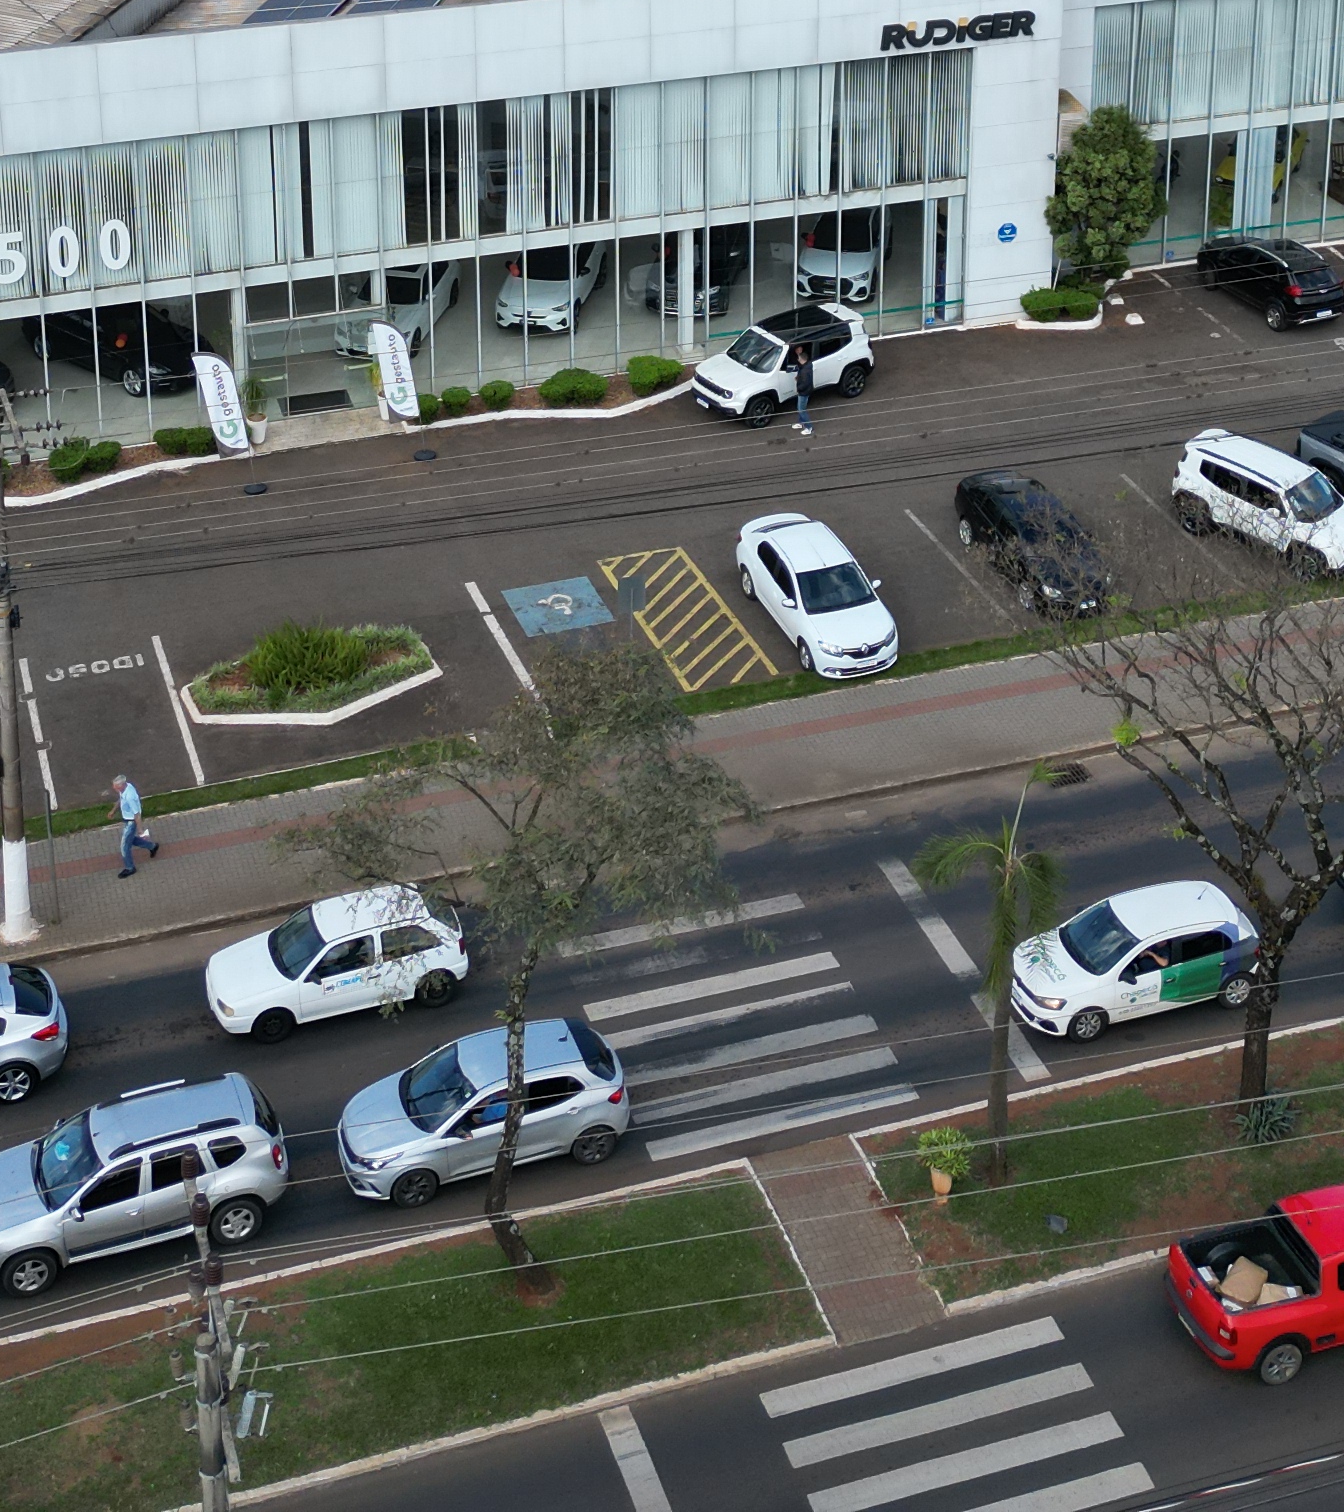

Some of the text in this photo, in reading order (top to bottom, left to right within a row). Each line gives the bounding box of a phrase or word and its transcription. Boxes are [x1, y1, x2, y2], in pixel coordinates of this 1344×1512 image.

[388, 334, 406, 384] gestauto
[212, 364, 234, 417] gestauto
[45, 653, 145, 682] IDOSO
